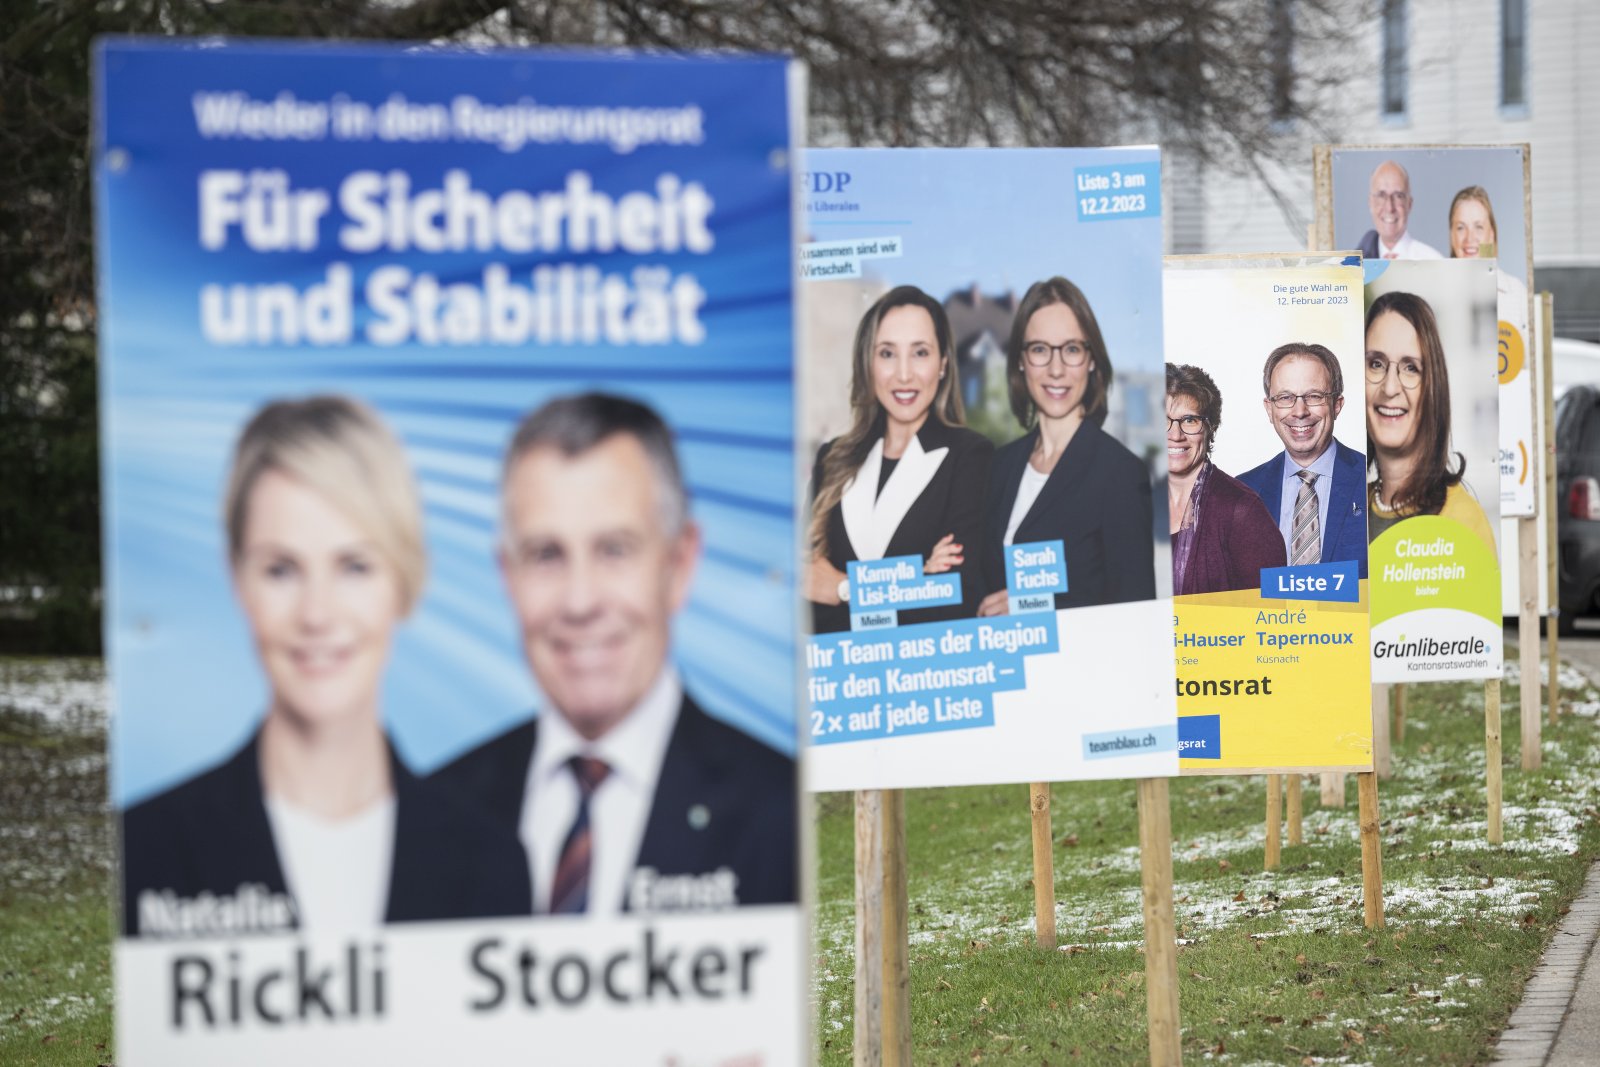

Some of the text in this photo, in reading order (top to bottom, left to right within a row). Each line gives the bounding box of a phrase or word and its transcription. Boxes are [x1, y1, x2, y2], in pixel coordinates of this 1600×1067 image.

[193, 90, 704, 152] Wieder in den Regierungsrat
[1077, 171, 1146, 191] Liste 3 am
[199, 167, 714, 254] Für Sicherheit
[814, 201, 860, 212] Liberalen
[1080, 194, 1146, 215] 12.2.2023
[856, 242, 878, 255] sind
[880, 241, 897, 253] wir
[1273, 284, 1288, 293] Die
[1289, 285, 1309, 295] gute
[1310, 284, 1332, 292] Wahl
[201, 262, 706, 346] und Stabilität
[1277, 296, 1349, 305] 12. Februar 2023
[1014, 547, 1056, 568] Sarah
[1395, 538, 1454, 558] Claudia
[857, 560, 915, 586] Kamylla
[1016, 569, 1060, 589] Fuchs
[1383, 561, 1465, 582] Hollenstein
[1278, 573, 1345, 592] Liste 7
[1415, 586, 1440, 596] bisher
[858, 580, 954, 607] Lisi-Brandino
[1018, 598, 1049, 610] Meilen
[861, 615, 892, 628] Meilen
[1255, 609, 1307, 625] André
[805, 622, 1048, 669] Ihr Team aus der Region
[1256, 631, 1354, 649] Tapernoux
[1181, 656, 1199, 665] See
[1256, 654, 1300, 665] Küsnacht
[1407, 658, 1488, 671] Kantonsratswahlen
[807, 677, 838, 703] für
[842, 672, 880, 698] den
[885, 661, 996, 694] Kantonsrat
[848, 704, 882, 732] auf
[886, 699, 930, 733] jede
[933, 696, 983, 723] Liste
[1088, 733, 1157, 753] teamblau.ch
[138, 882, 297, 933] Natalie
[170, 928, 765, 1031] Rickli Stocker
